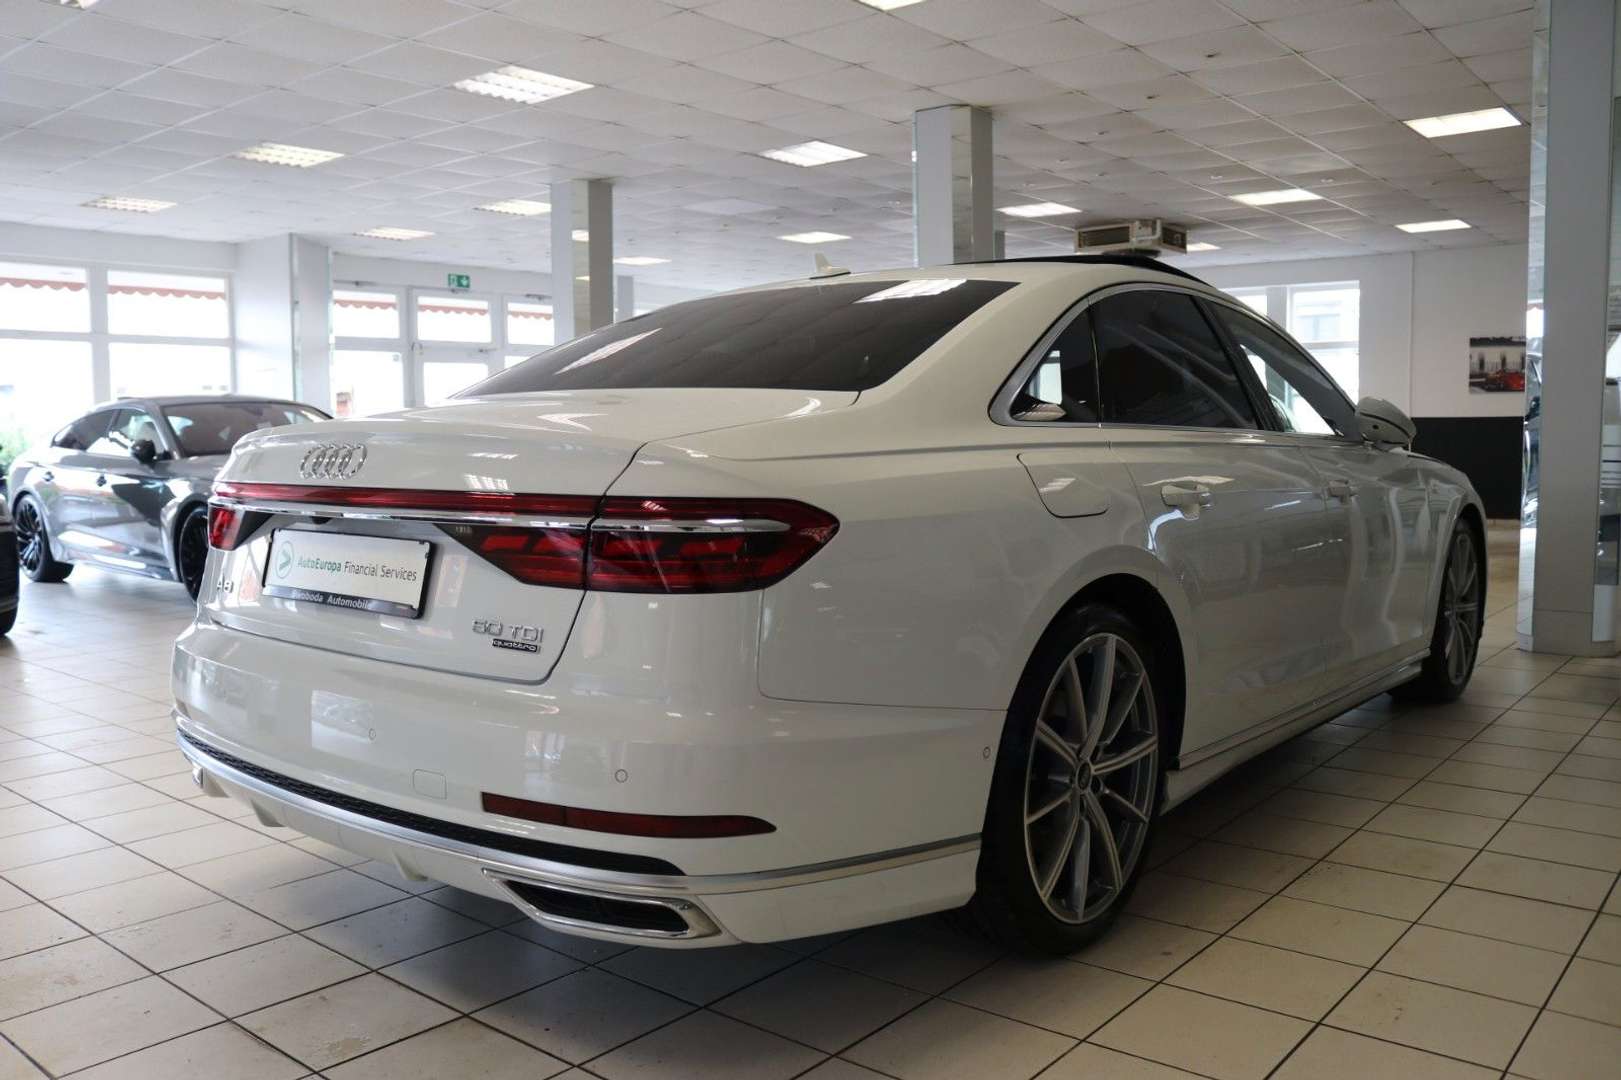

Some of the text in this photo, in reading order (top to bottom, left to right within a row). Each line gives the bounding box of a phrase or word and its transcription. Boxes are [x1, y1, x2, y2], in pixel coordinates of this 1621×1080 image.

[297, 557, 417, 582] AutoEuropa Financial Services
[509, 624, 544, 643] TDI
[493, 639, 538, 652] quattro
